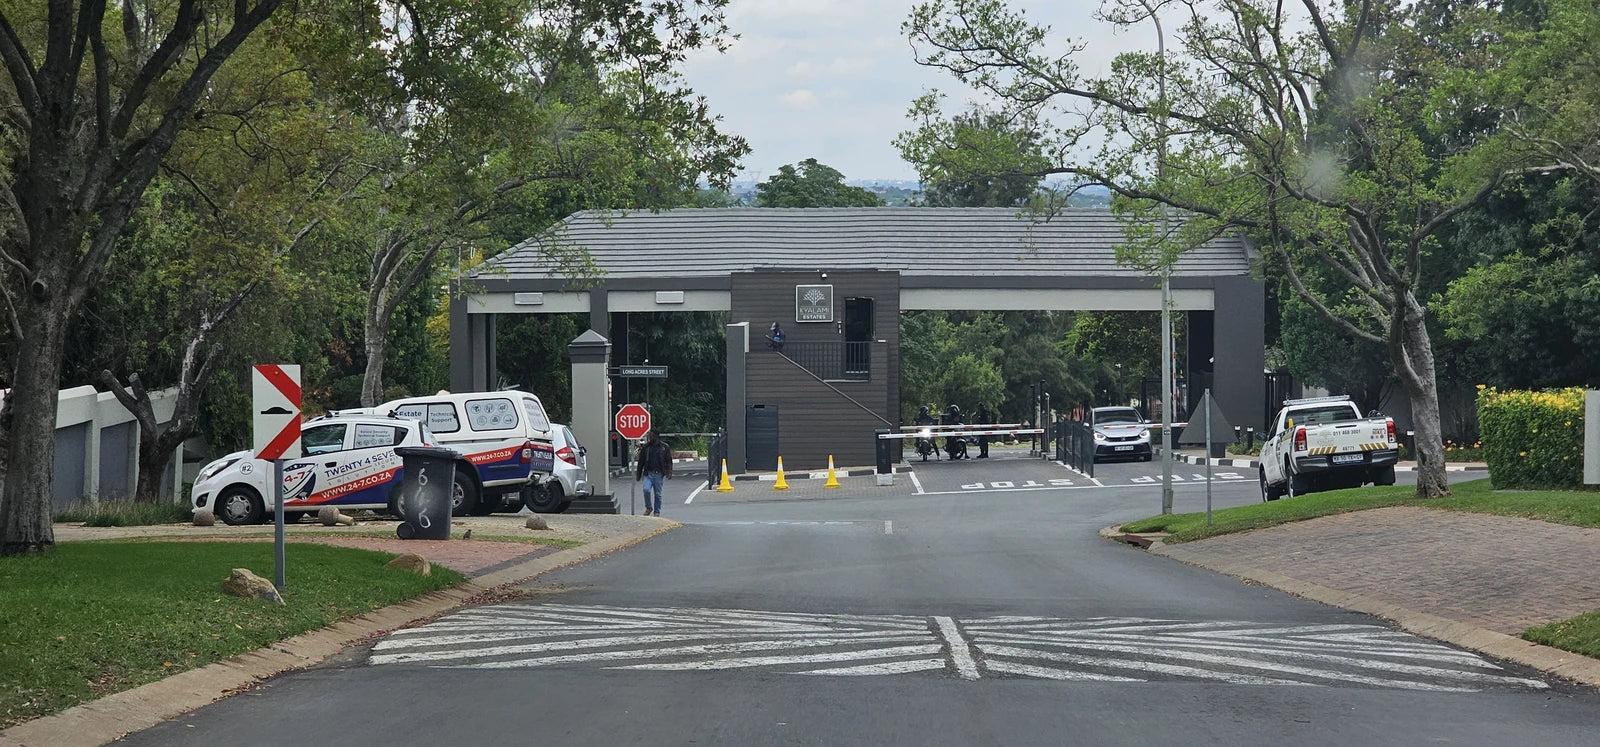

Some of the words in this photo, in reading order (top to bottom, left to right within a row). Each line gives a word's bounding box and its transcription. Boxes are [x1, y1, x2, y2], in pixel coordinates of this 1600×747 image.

[620, 415, 647, 428] STOP
[374, 456, 399, 467] SECURIT
[471, 450, 512, 462] WWW.24-7.CO.ZA
[324, 460, 363, 478] TWENTY
[372, 450, 395, 463] SEVE
[321, 471, 392, 499] WWW.24-7.CO.ZA
